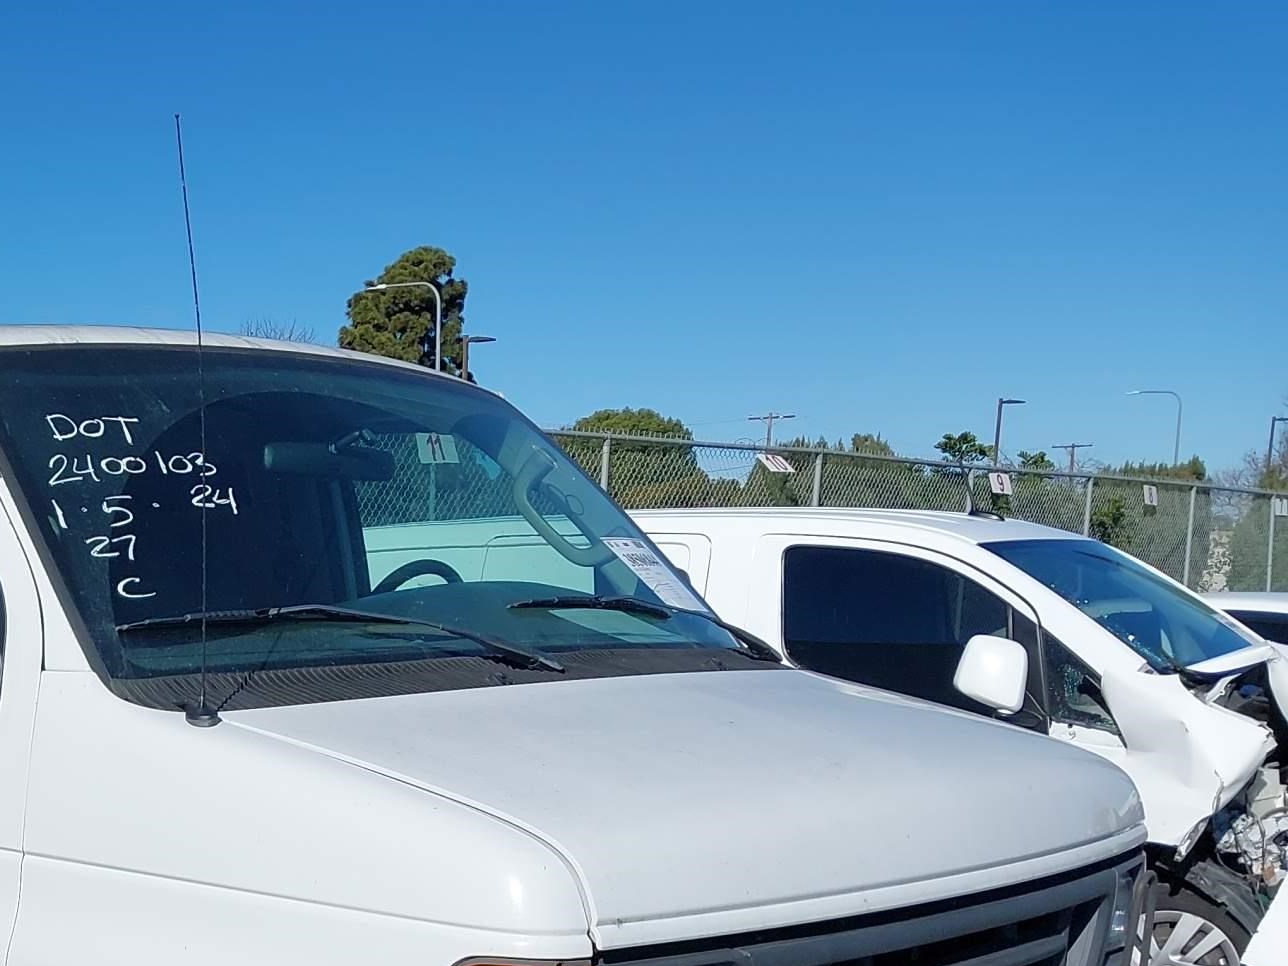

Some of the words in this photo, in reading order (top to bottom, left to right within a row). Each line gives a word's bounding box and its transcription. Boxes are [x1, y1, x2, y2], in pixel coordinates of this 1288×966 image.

[45, 413, 140, 446] DOT
[996, 473, 1005, 492] 9
[84, 534, 137, 561] 27
[117, 577, 157, 598] C
